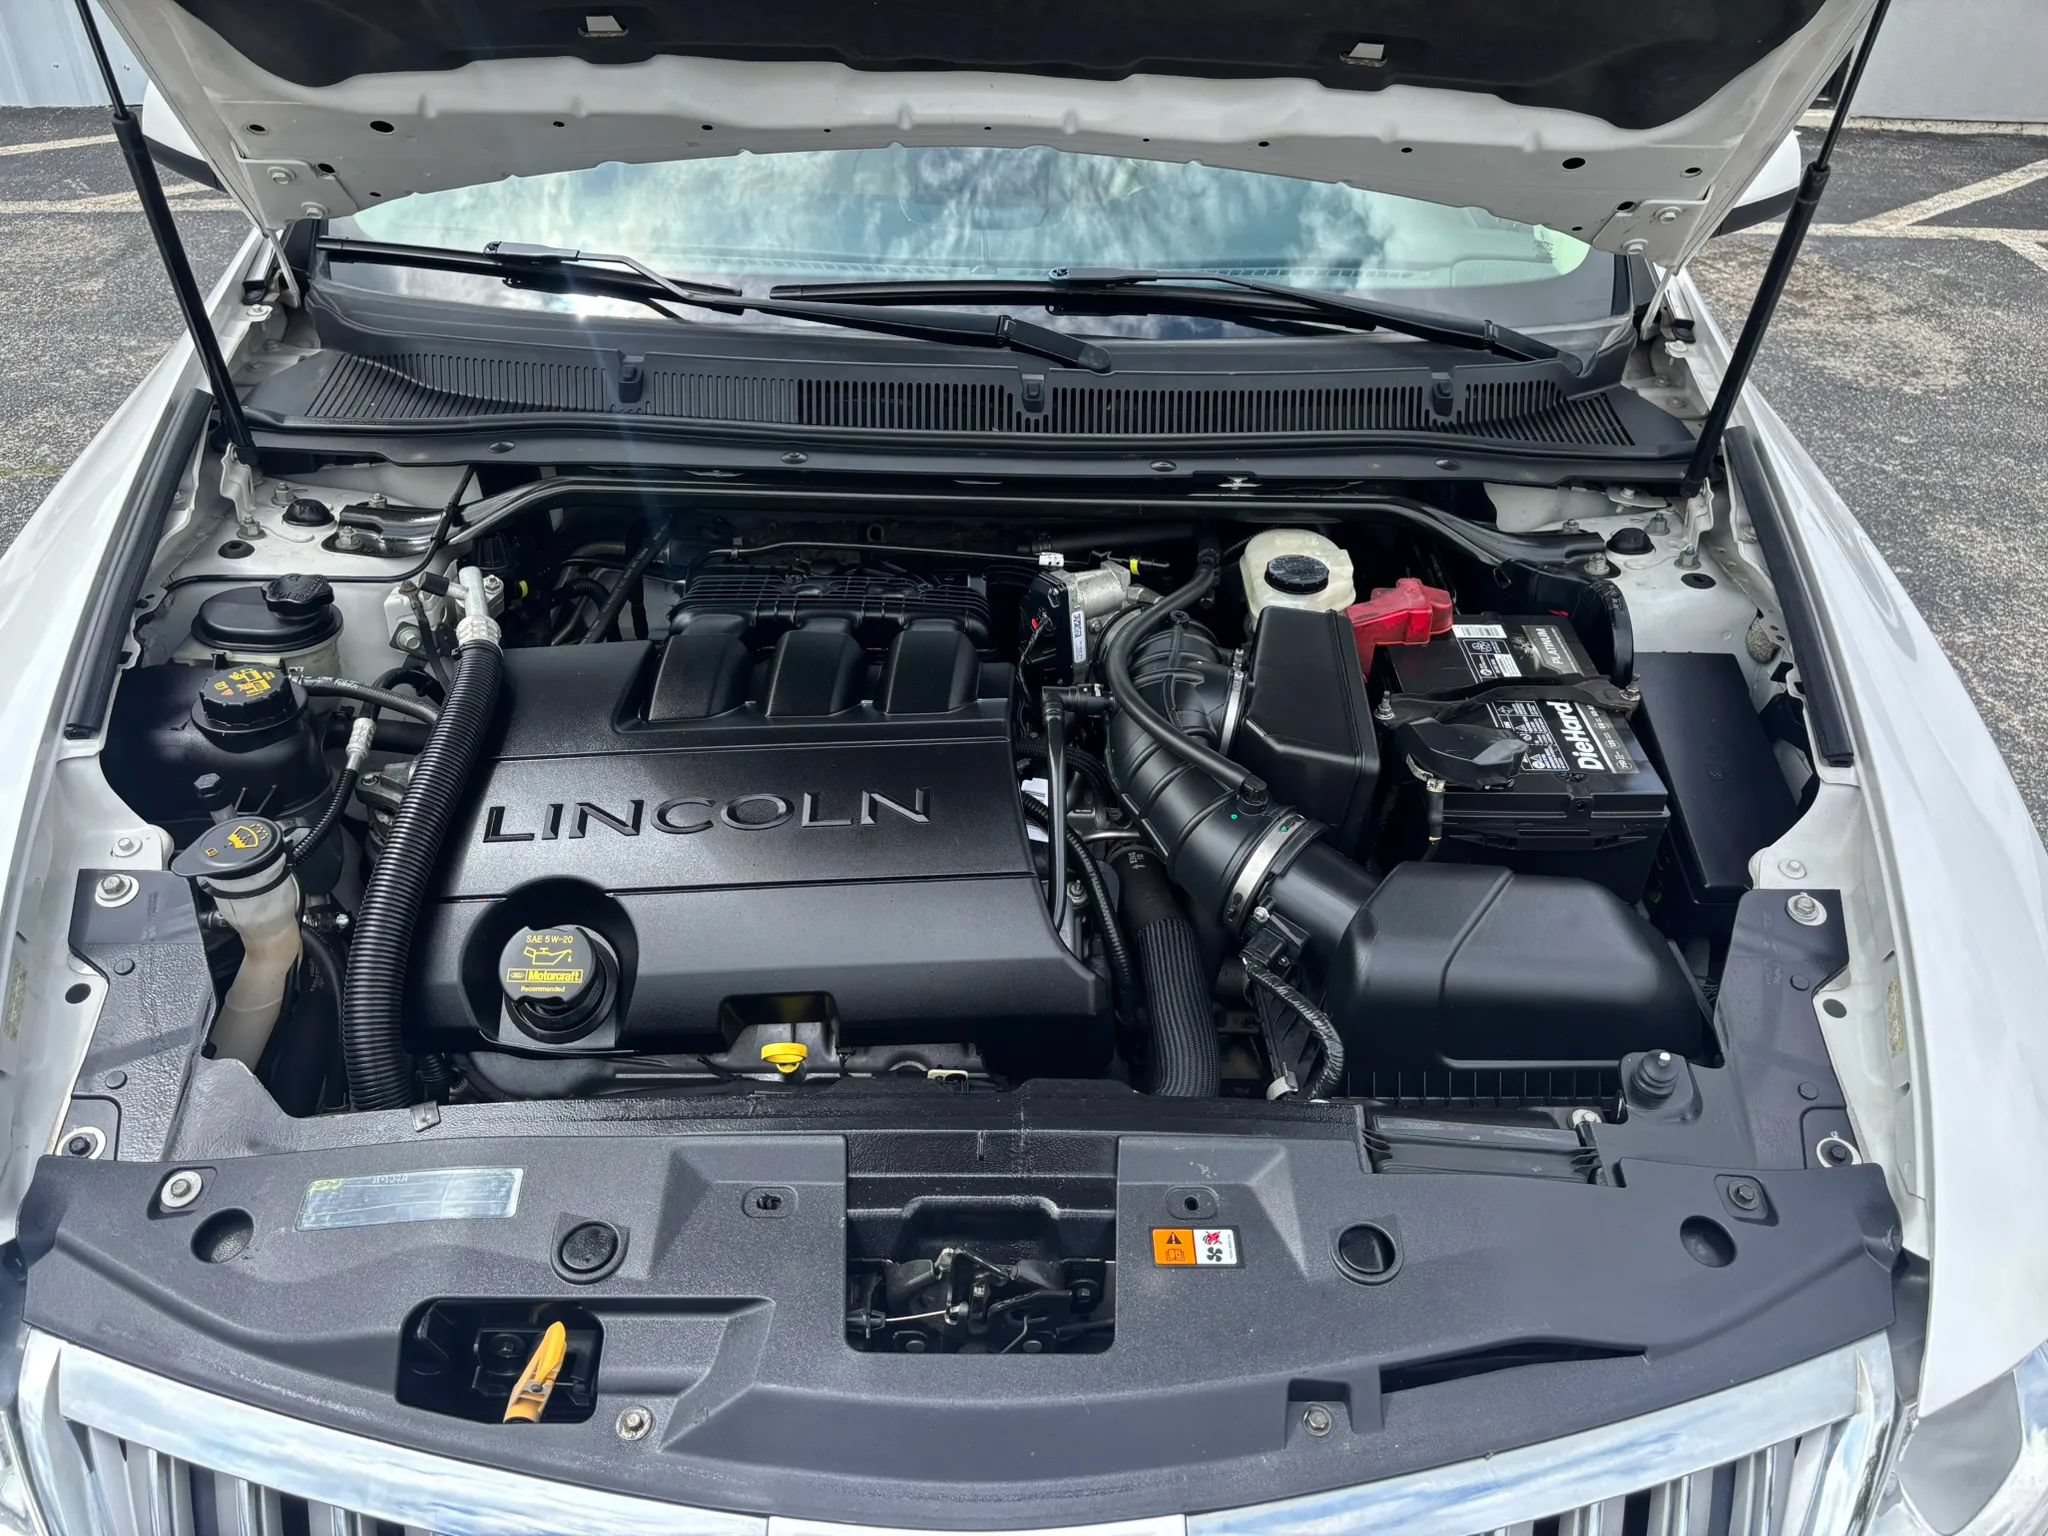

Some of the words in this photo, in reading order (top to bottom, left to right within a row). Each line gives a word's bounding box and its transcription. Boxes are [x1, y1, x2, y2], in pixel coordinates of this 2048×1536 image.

[1535, 628, 1563, 665] PLATINUM
[1546, 701, 1605, 770] DieHard
[483, 786, 931, 843] LINCOLN
[526, 935, 543, 944] SAE
[527, 969, 579, 981] Motorcraft
